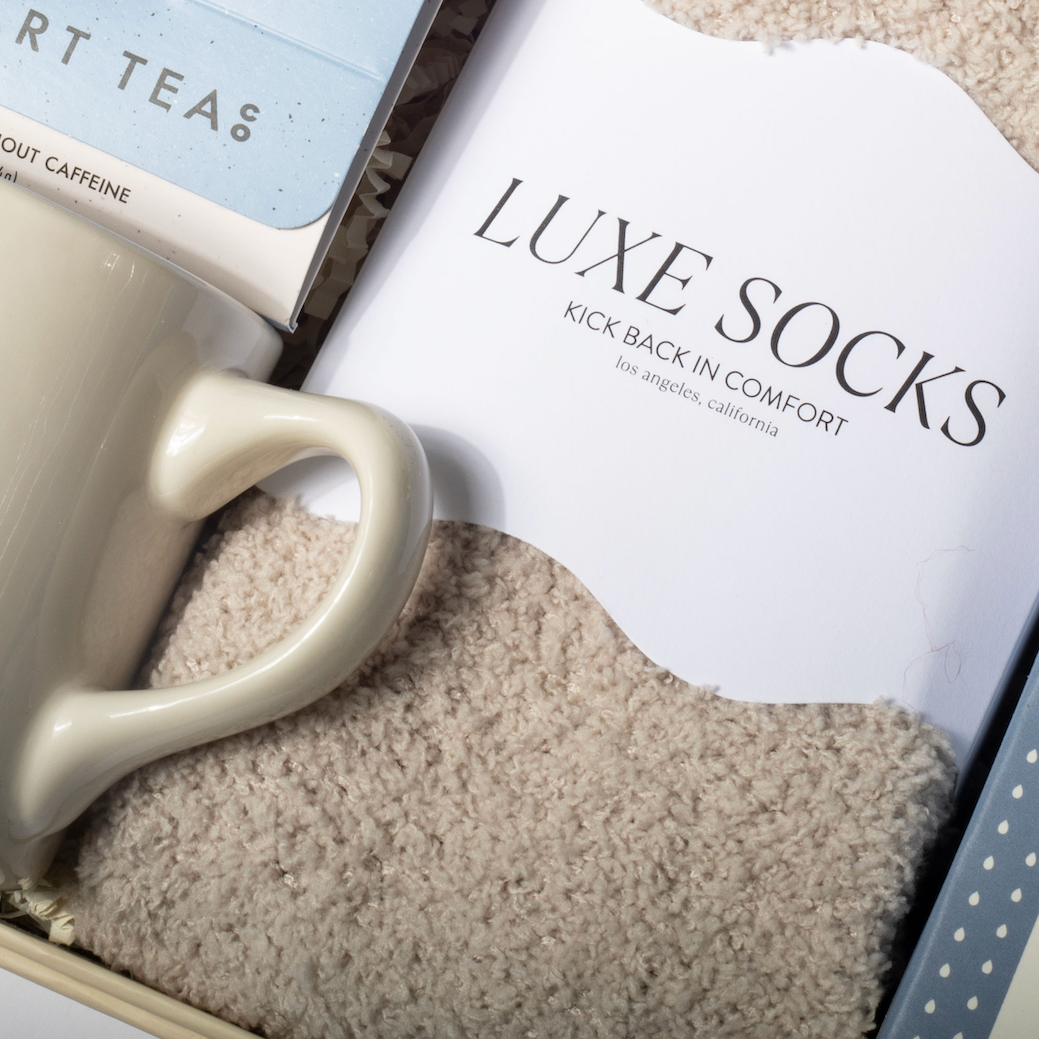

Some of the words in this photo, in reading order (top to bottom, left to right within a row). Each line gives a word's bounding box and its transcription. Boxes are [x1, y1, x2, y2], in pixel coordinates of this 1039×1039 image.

[0, 133, 41, 163] OUT
[45, 156, 131, 204] CAFFEINE
[474, 178, 713, 316] LUXE
[714, 277, 1006, 447] SOCKS
[564, 301, 621, 338] KICK
[623, 325, 691, 368] BACK
[692, 355, 720, 381] IN
[725, 371, 849, 436] COMFORT
[615, 355, 639, 375] los
[642, 371, 701, 405] angeles,
[707, 400, 778, 437] california
